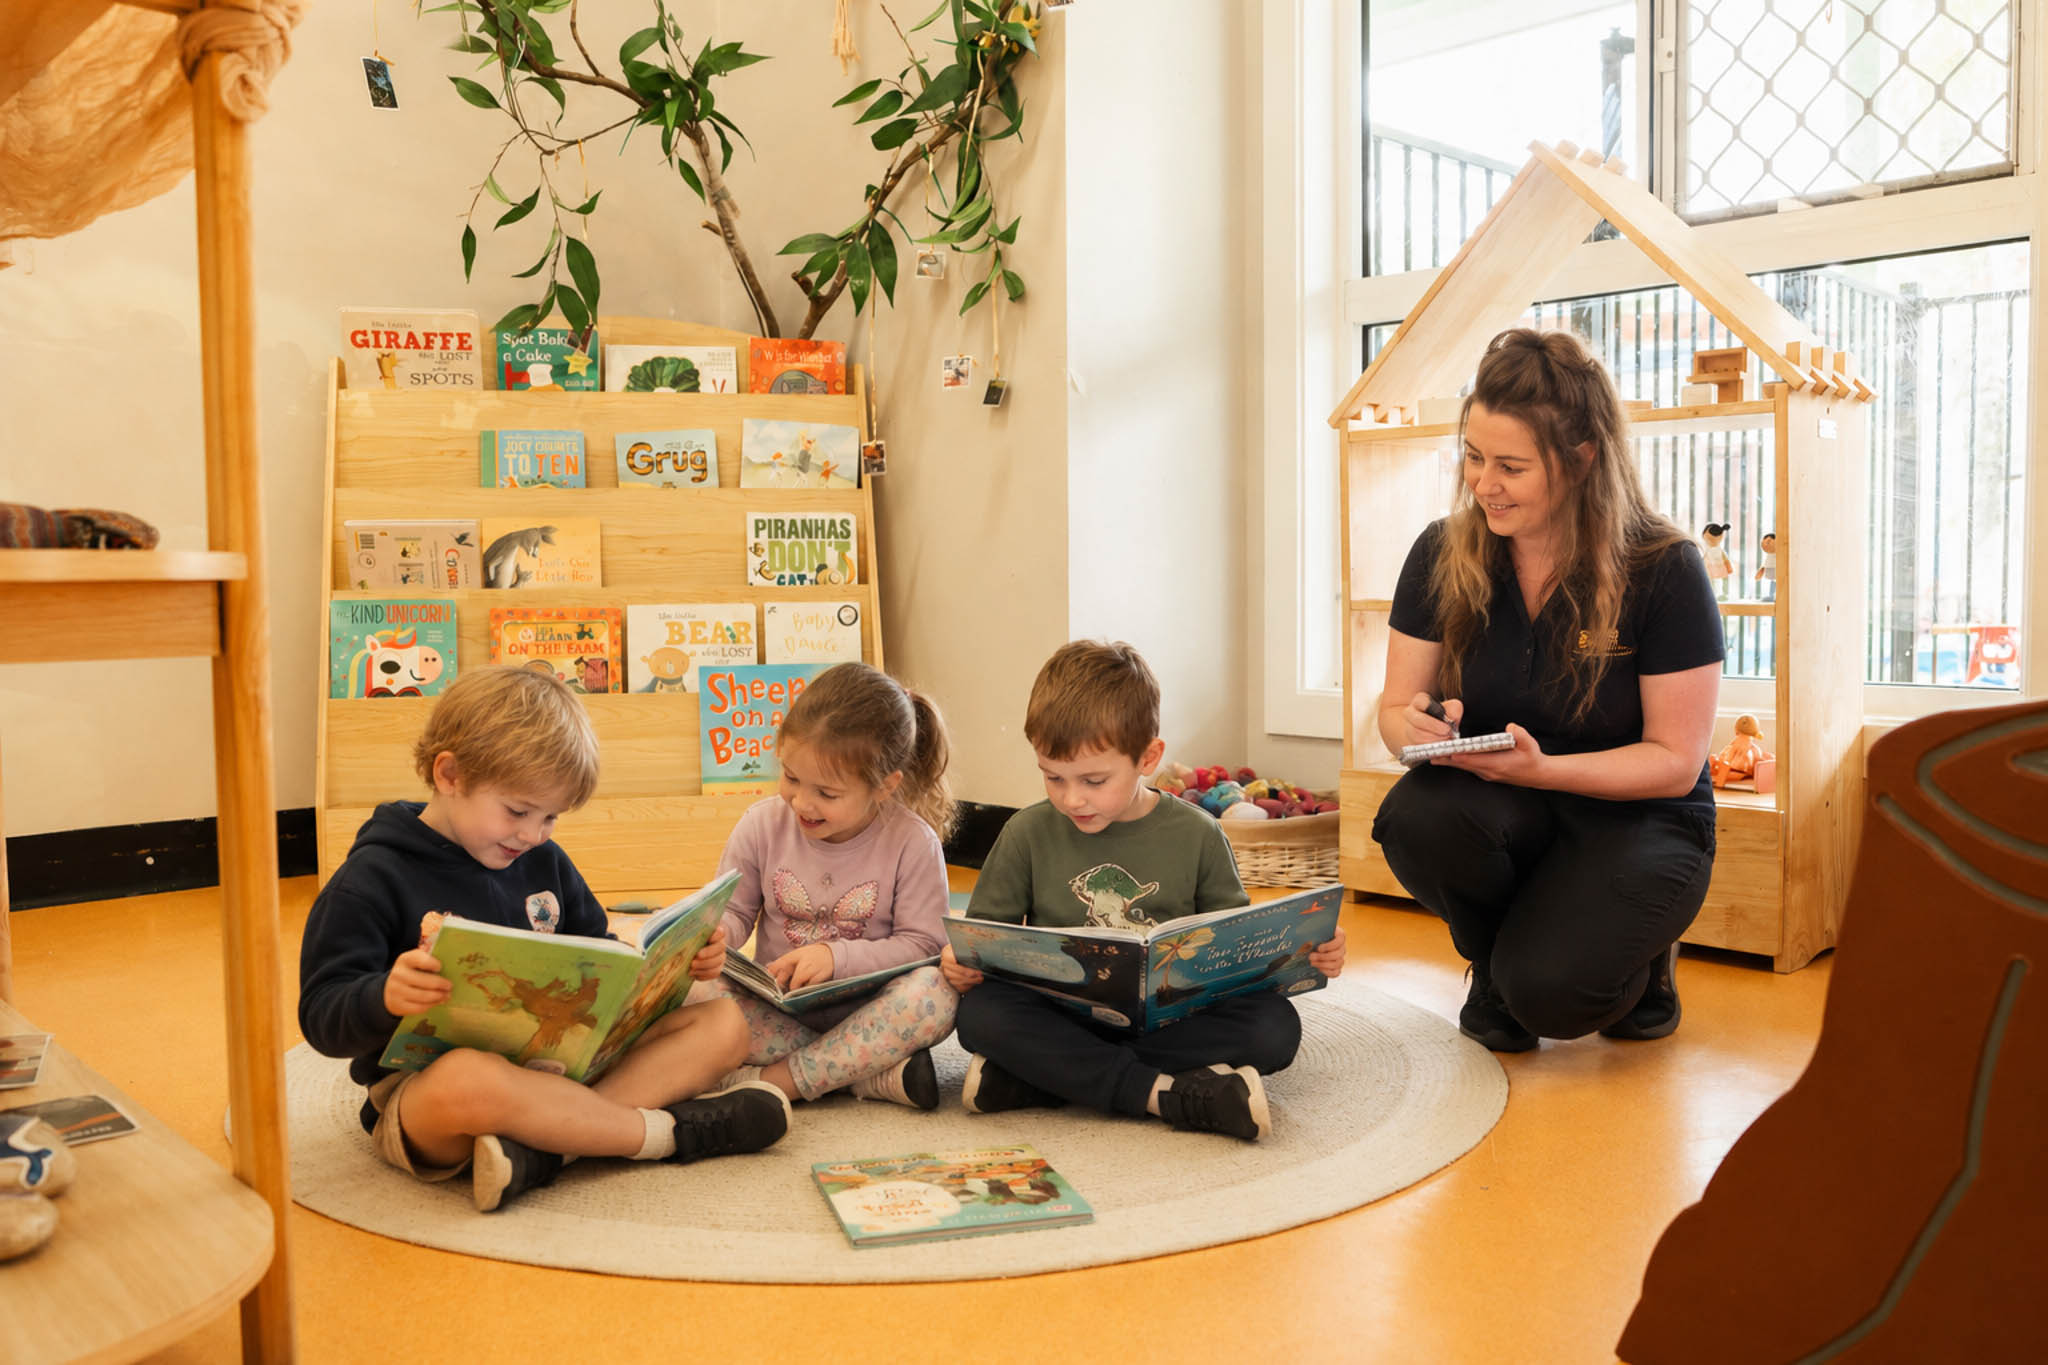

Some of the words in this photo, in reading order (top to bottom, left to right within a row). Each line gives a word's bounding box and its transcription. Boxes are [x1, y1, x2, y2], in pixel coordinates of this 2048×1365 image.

[350, 329, 473, 351] GIRAFFE
[502, 332, 535, 348] Spot
[439, 351, 474, 361] LOST
[503, 352, 513, 362] a
[515, 348, 552, 362] Cake
[410, 372, 474, 386] SPOTS
[503, 453, 531, 476] TO
[535, 453, 580, 476] TEN
[626, 441, 708, 483] Grug
[754, 518, 852, 540] PIRANHAS
[768, 540, 851, 576] DON'T
[351, 603, 385, 624] KIND
[386, 602, 452, 624] UNICORN
[792, 610, 837, 633] Baby
[664, 620, 754, 645] BEAR
[508, 642, 529, 655] ON
[535, 642, 561, 656] THE
[721, 647, 753, 658] LOST
[707, 672, 806, 714] Sheep
[731, 708, 763, 728] on
[708, 726, 784, 765] Beac
